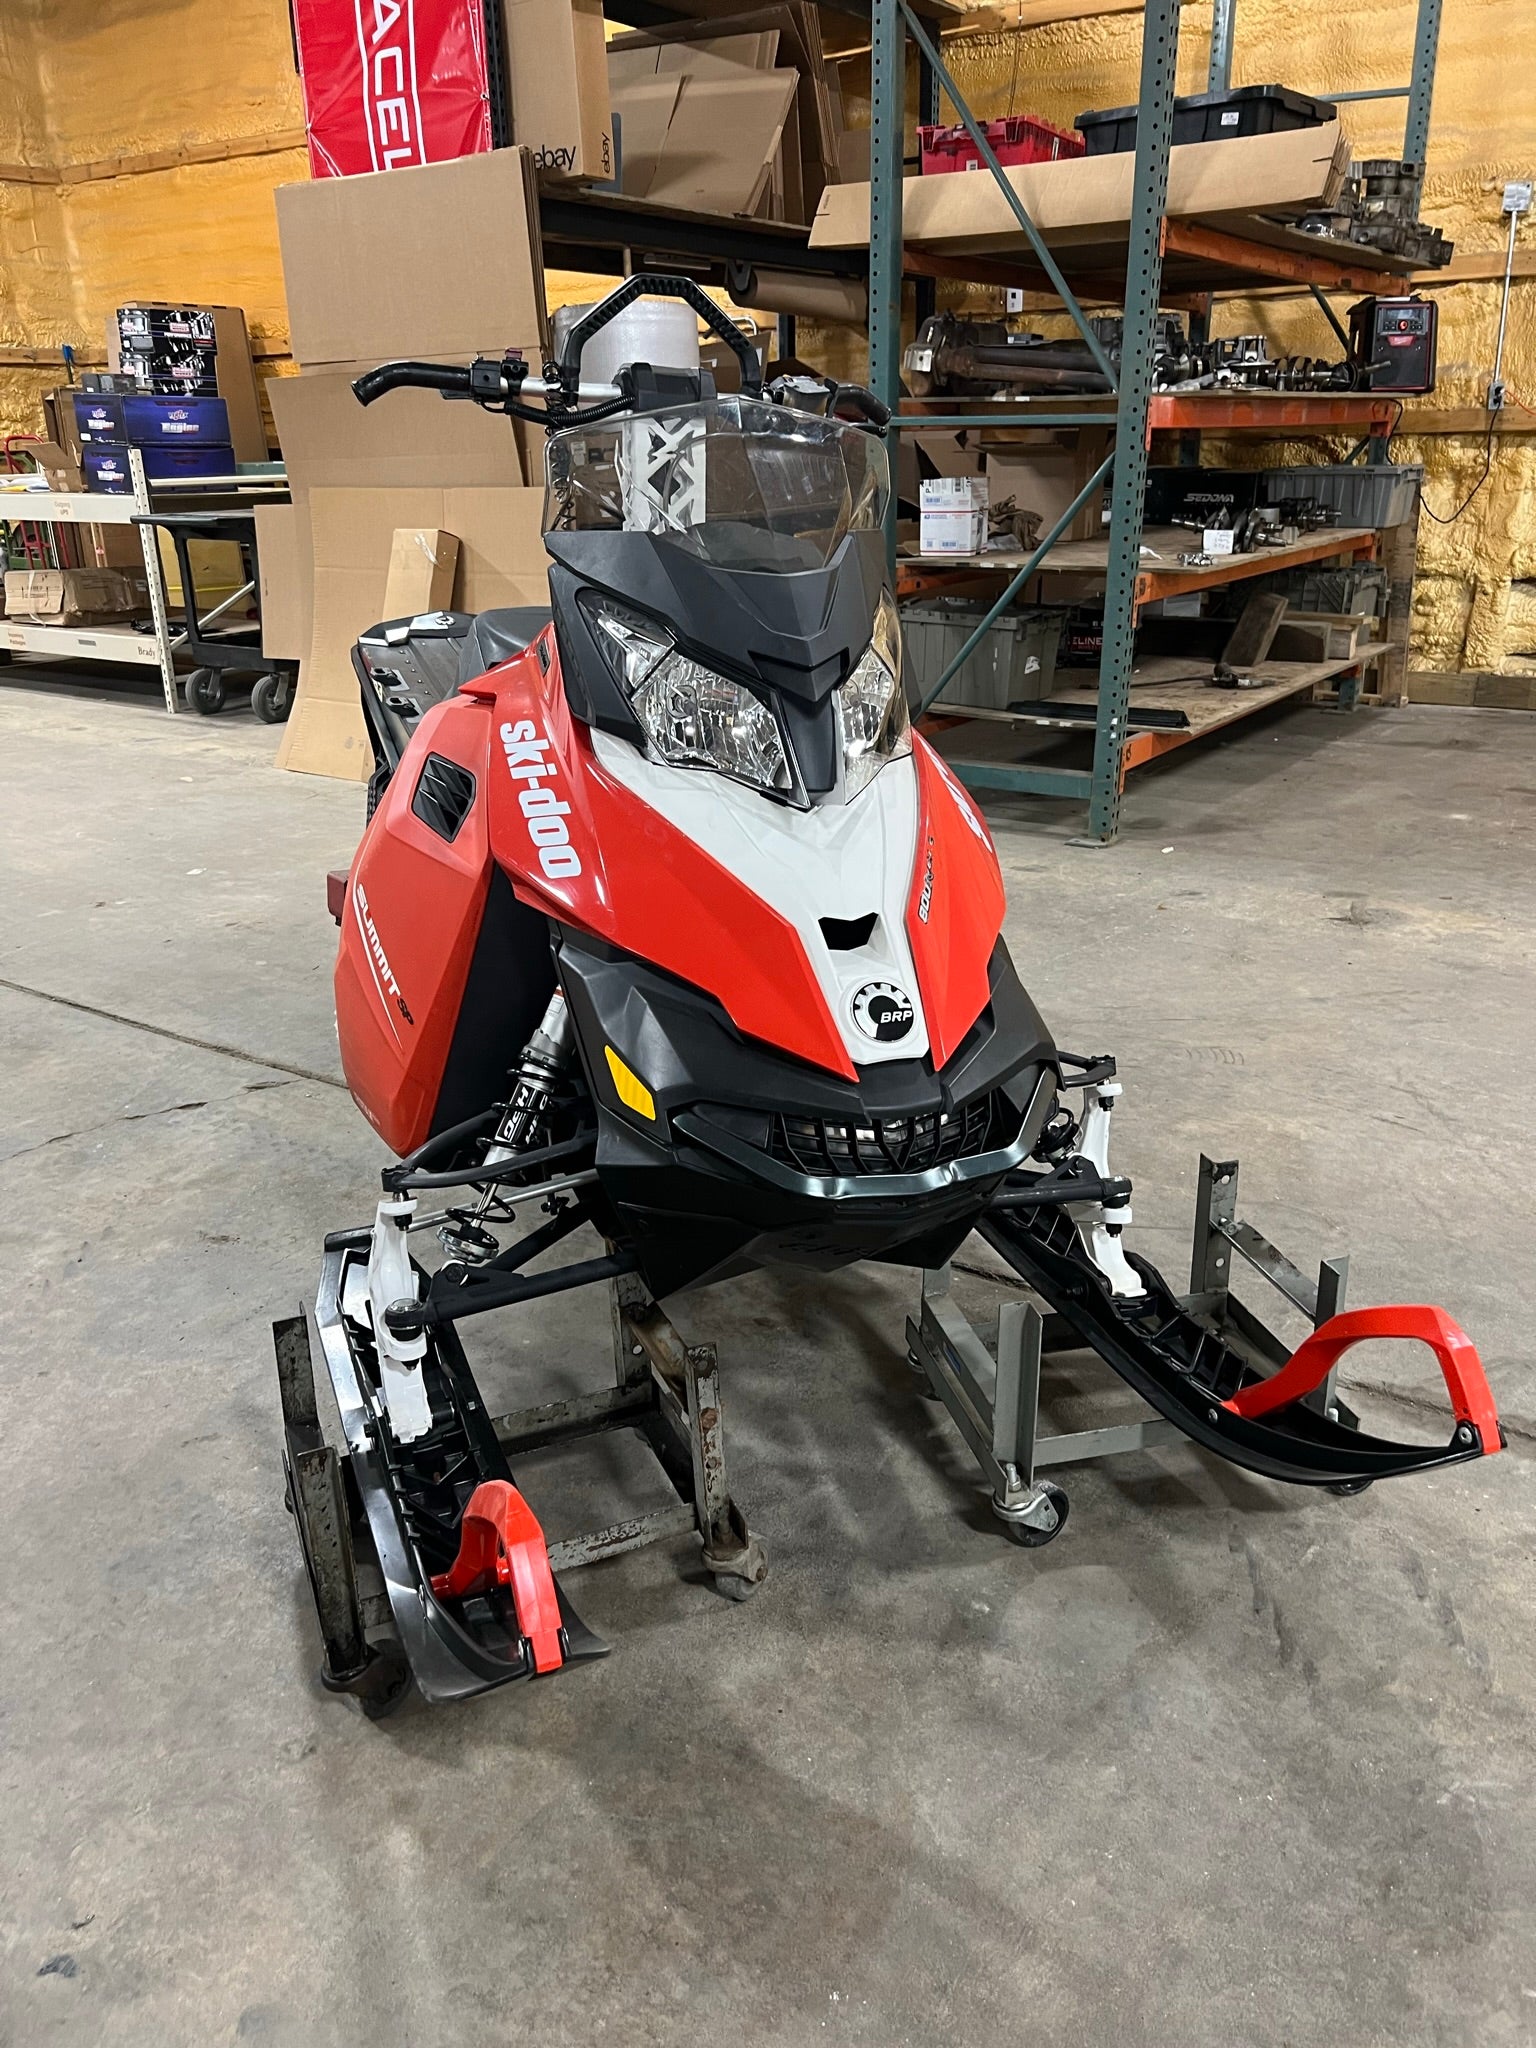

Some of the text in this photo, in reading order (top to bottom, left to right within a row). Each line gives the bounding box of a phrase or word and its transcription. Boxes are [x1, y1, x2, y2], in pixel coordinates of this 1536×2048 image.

[534, 144, 576, 171] ebay
[601, 132, 611, 174] ebay
[1183, 493, 1235, 503] SEDONA
[138, 645, 156, 660] Brady
[499, 719, 583, 879] ski-doo
[880, 1010, 913, 1024] BRP
